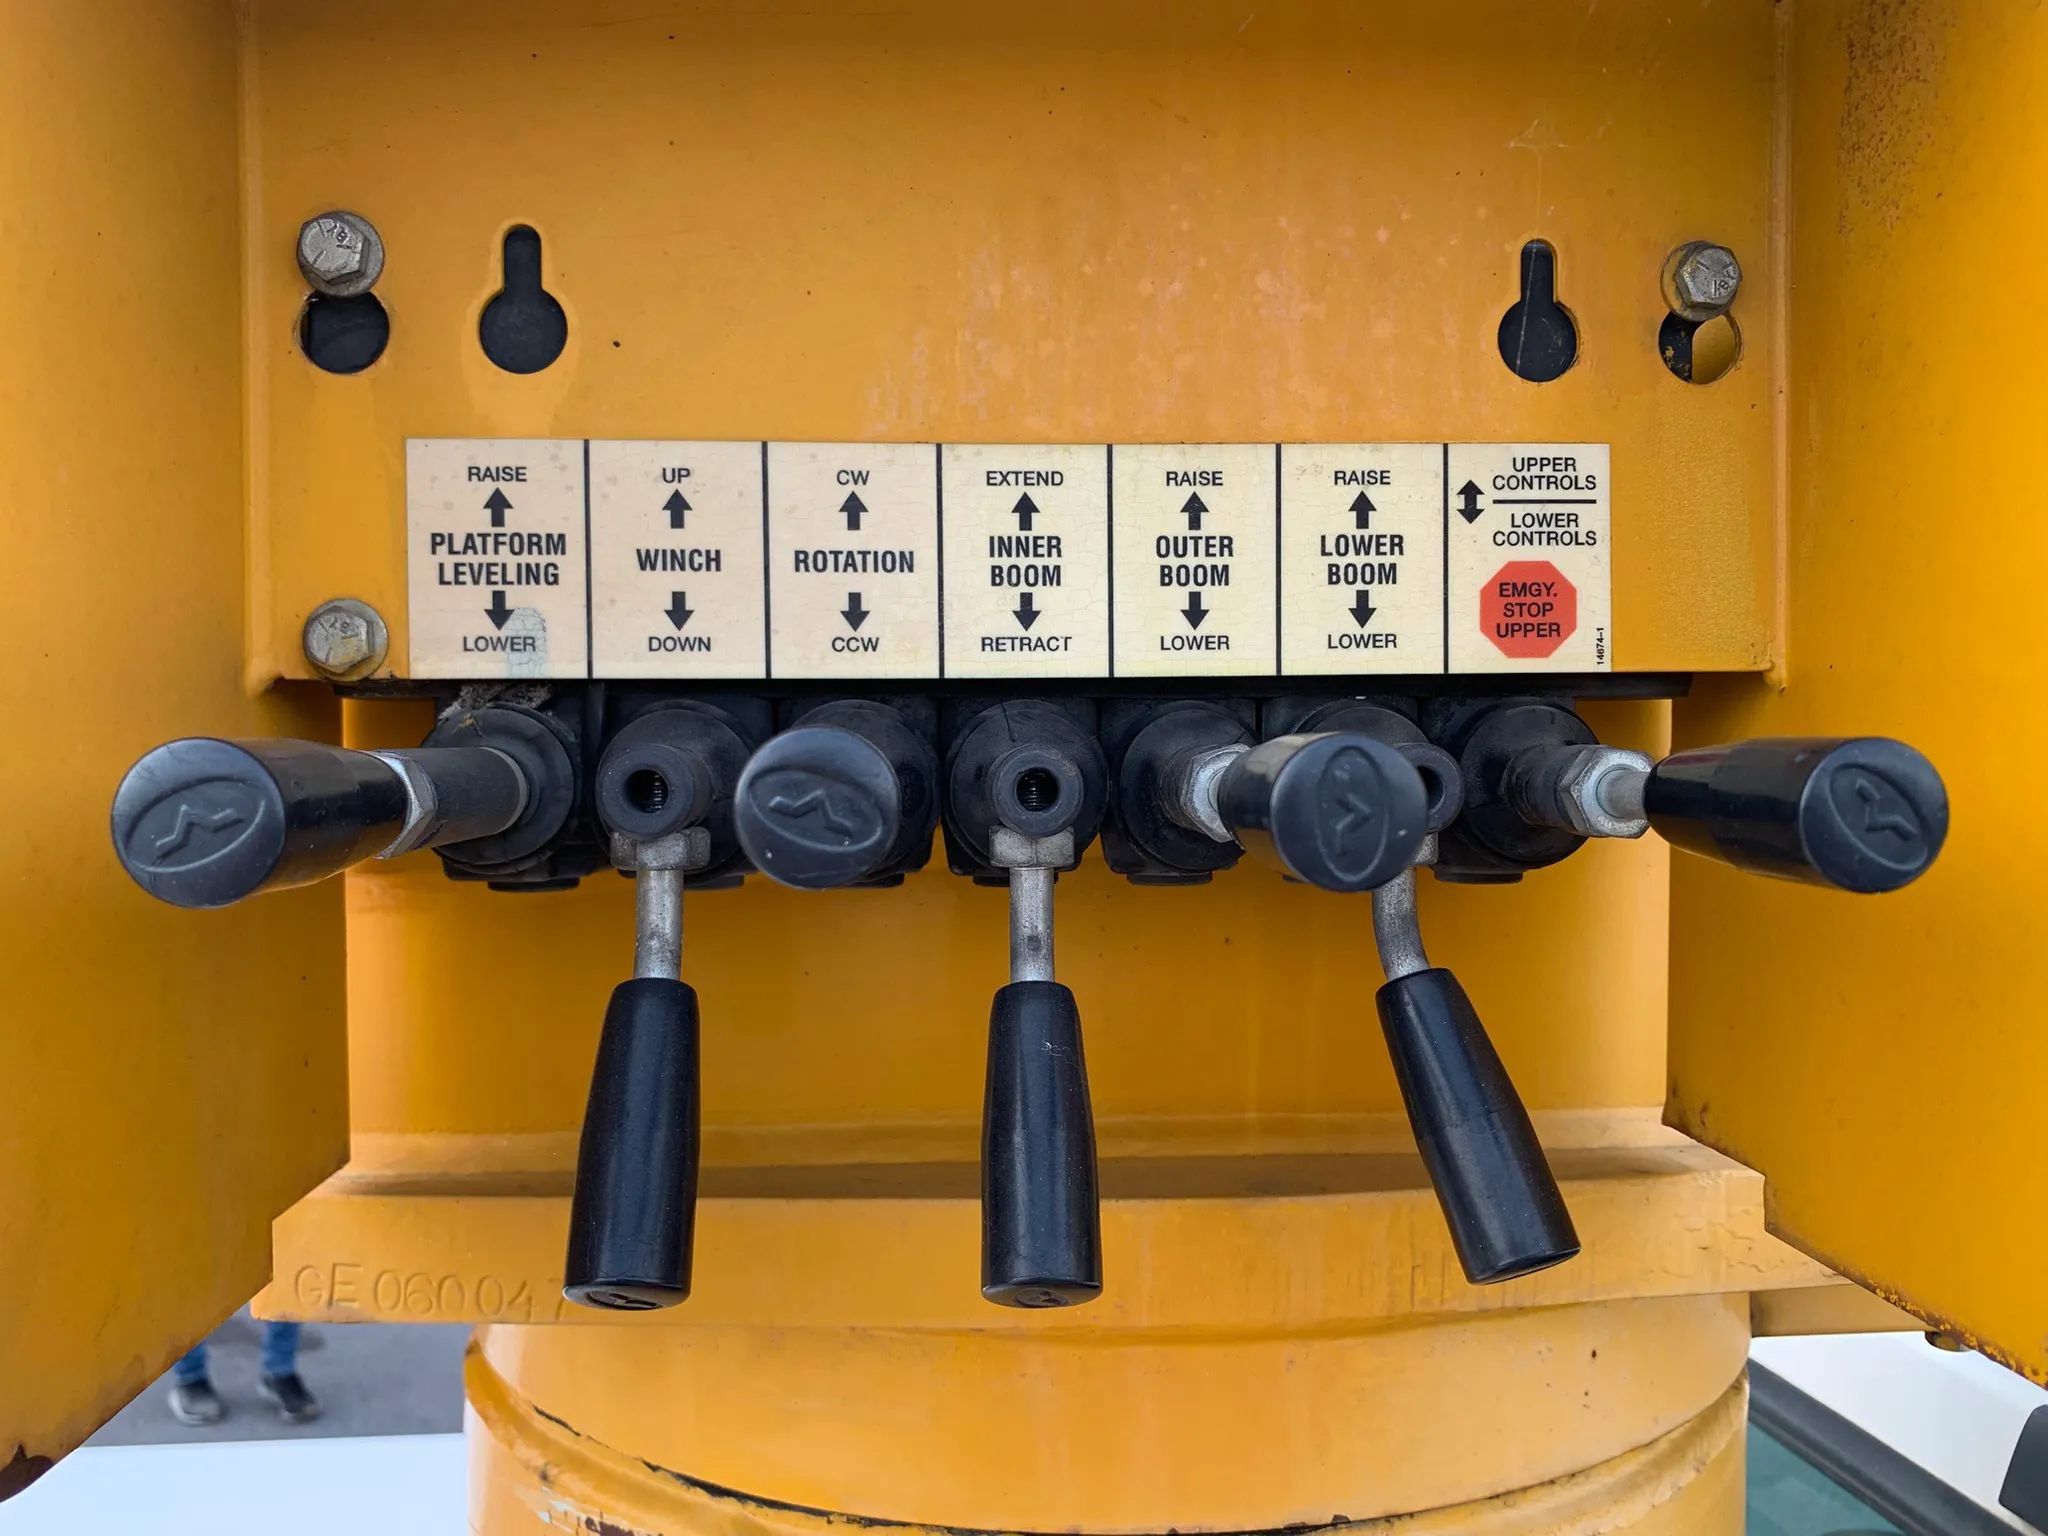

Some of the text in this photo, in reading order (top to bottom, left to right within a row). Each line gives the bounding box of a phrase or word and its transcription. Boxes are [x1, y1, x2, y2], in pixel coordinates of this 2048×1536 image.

[1512, 456, 1577, 473] UPPER
[467, 465, 528, 483] RAISE
[662, 467, 691, 484] UP
[836, 469, 870, 486] CW
[986, 470, 1064, 487] EXTEND
[1166, 470, 1224, 487] RAISE
[1334, 469, 1391, 486] RAISE
[1492, 474, 1597, 491] CONTROLS
[1511, 512, 1579, 529] LOWER
[430, 532, 567, 556] PLATFORM
[989, 535, 1062, 558] INNER
[1155, 535, 1234, 559] OUTER
[1320, 533, 1404, 557] LOWER
[1492, 530, 1597, 547] CONTROLS
[635, 548, 722, 573] WINCH
[794, 549, 914, 574] ROTATION
[438, 562, 559, 586] LEVELING
[990, 564, 1061, 588] BOOM
[1159, 563, 1230, 587] BOOM
[1327, 562, 1397, 586] BOOM
[1499, 581, 1558, 598] EMGY.
[1503, 601, 1554, 618] STOP
[1496, 622, 1561, 639] UPPER
[463, 635, 537, 653] LOWER
[648, 635, 712, 653] DOWN
[831, 636, 880, 653] CCW
[981, 636, 1073, 652] RETRACT
[1160, 635, 1230, 651] LOWER
[1327, 633, 1397, 650] LOWER
[1595, 627, 1605, 666] 14674-1
